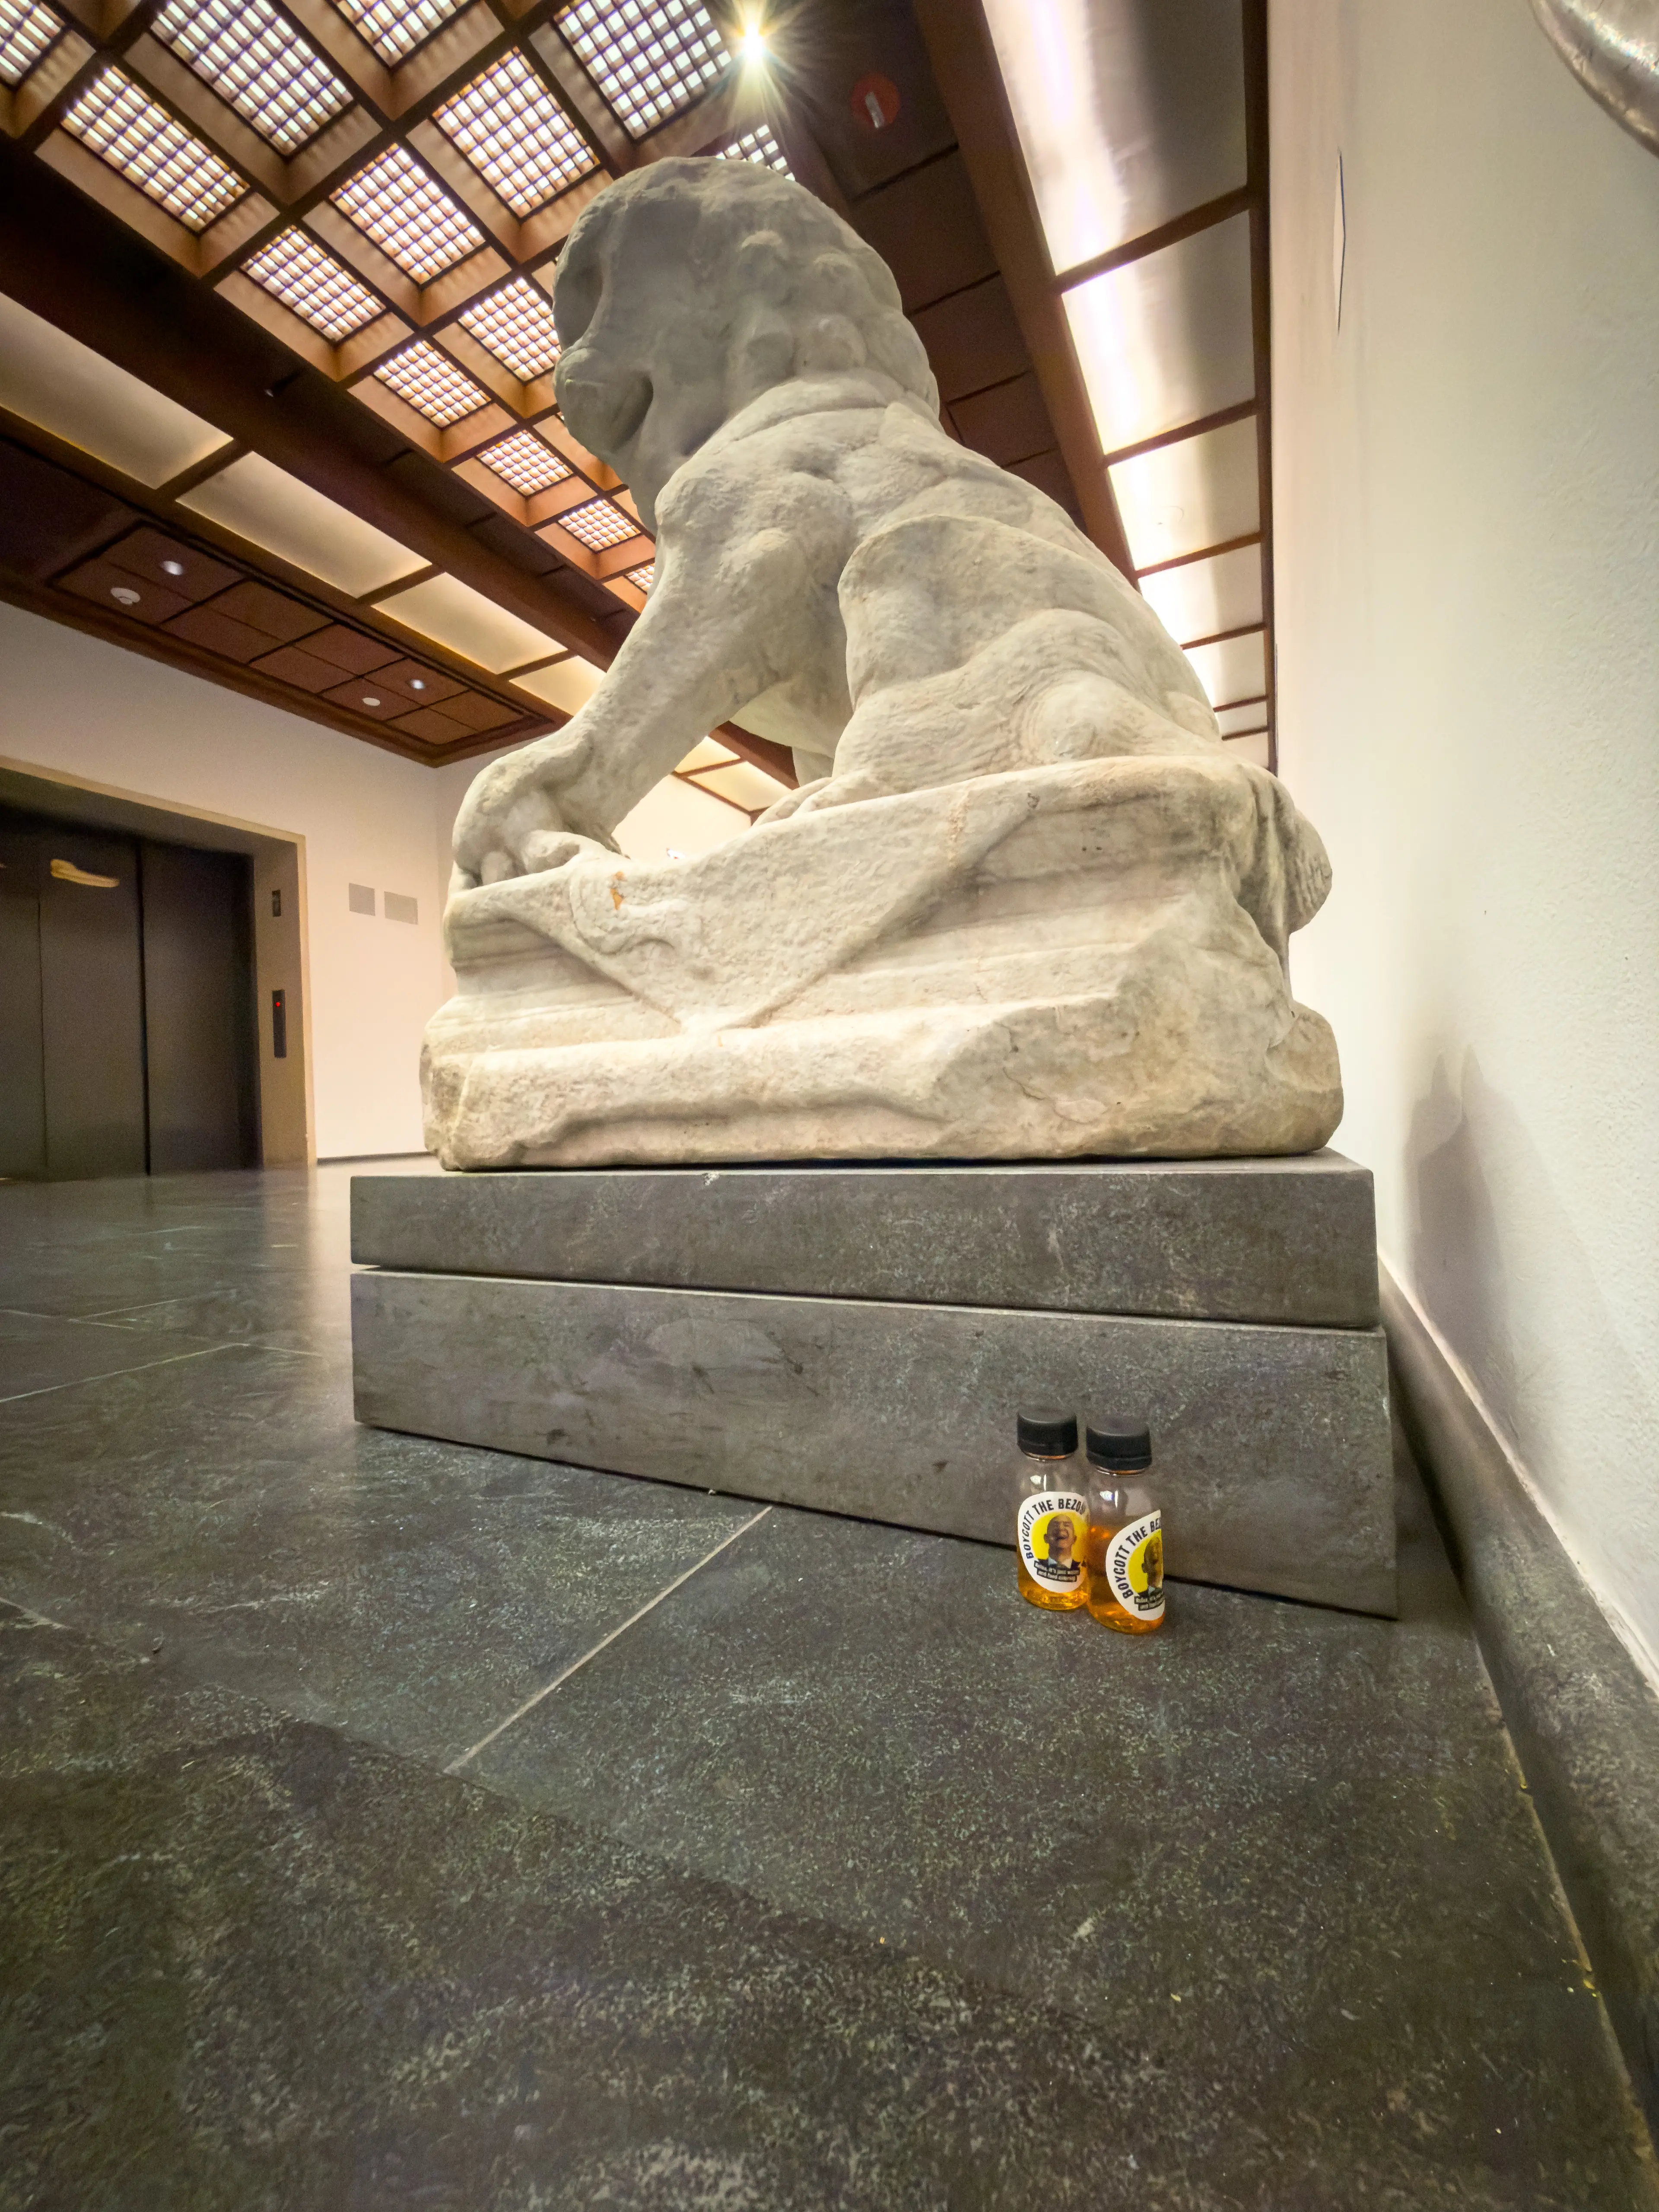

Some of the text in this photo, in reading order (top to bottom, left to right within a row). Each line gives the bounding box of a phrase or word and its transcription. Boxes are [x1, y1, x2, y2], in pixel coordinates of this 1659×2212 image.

[1022, 1510, 1034, 1559] BOYCOTT
[1032, 1500, 1054, 1515] THE
[1113, 1518, 1161, 1599] BOYCOTT THE BE
